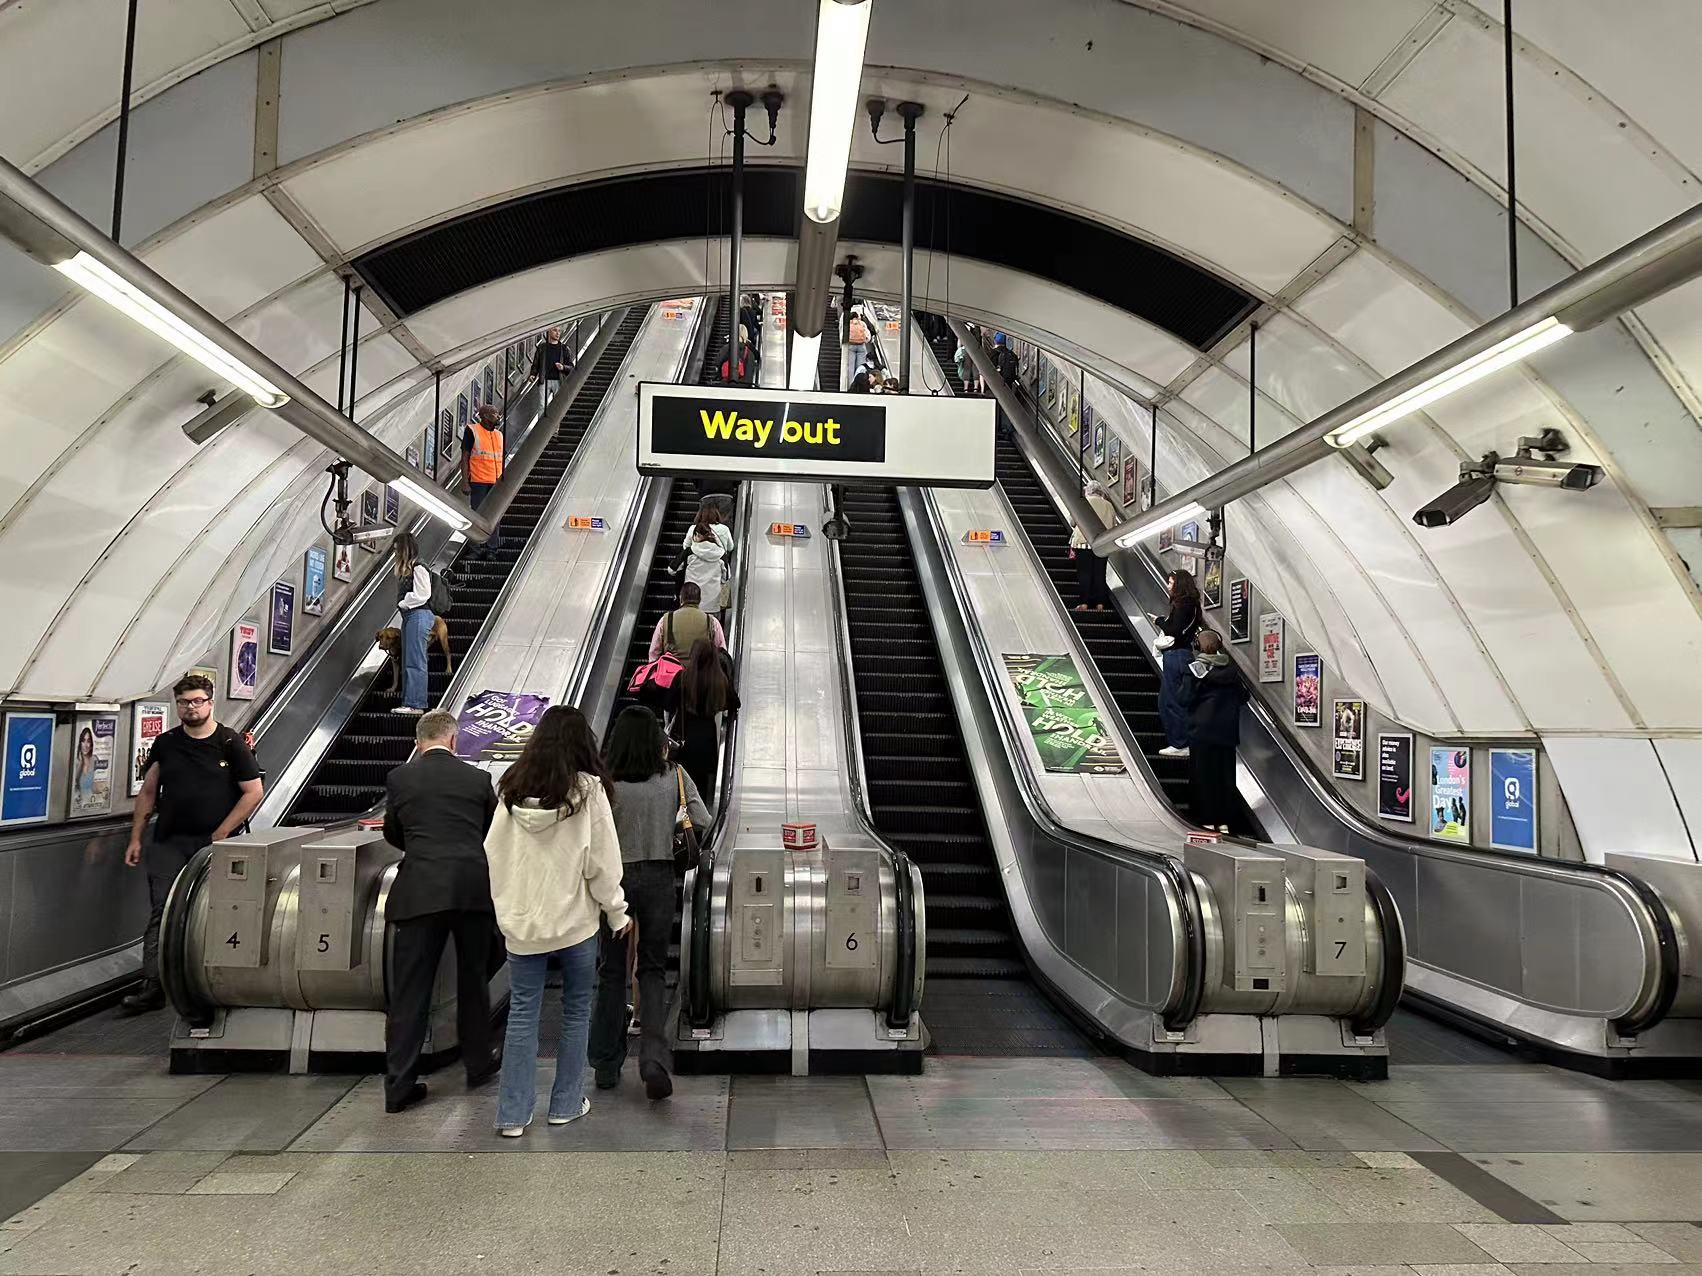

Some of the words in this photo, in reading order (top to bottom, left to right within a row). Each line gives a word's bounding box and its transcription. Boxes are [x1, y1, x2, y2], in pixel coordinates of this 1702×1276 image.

[700, 409, 773, 449] Way
[782, 417, 841, 445] out
[1031, 716, 1107, 747] HOLD
[1437, 774, 1466, 785] London's
[1435, 786, 1463, 796] Greatest
[226, 931, 241, 949] 4
[317, 933, 331, 953] 5
[845, 932, 859, 951] 6
[1334, 941, 1347, 960] 7
